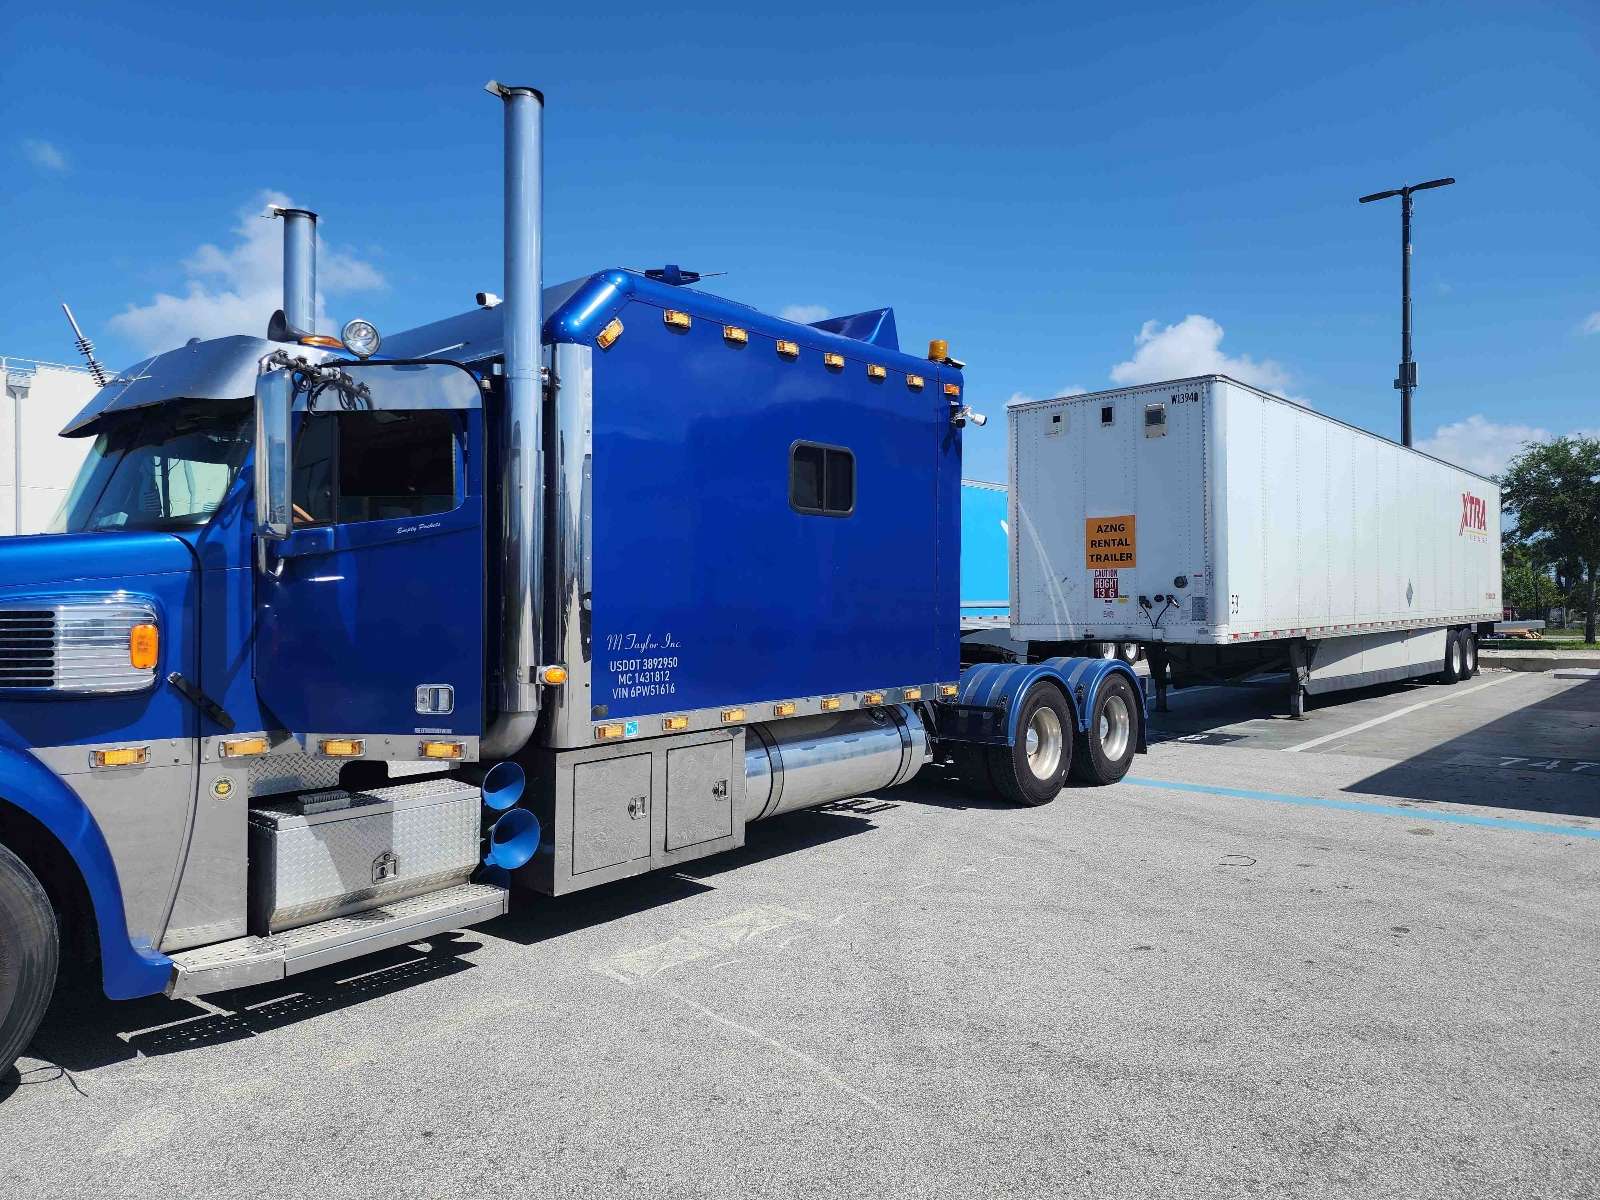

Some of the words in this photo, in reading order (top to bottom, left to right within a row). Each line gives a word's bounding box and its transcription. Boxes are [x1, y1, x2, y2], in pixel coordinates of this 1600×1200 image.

[1459, 491, 1486, 536] XTRA
[1096, 523, 1126, 534] AZNG
[1090, 538, 1131, 549] RENTAL
[1088, 552, 1133, 563] TRAILER
[1094, 569, 1118, 578] CAUTION
[1095, 578, 1118, 589] HEIGHT
[1096, 588, 1105, 598] 13
[606, 633, 623, 652] M
[624, 633, 659, 654] Taylor
[610, 659, 641, 672] USDOT
[642, 656, 678, 670] 3892950
[618, 673, 633, 686] MC
[634, 670, 670, 684] 1431812
[612, 687, 629, 700] VIN
[630, 682, 675, 698] 6PW51616
